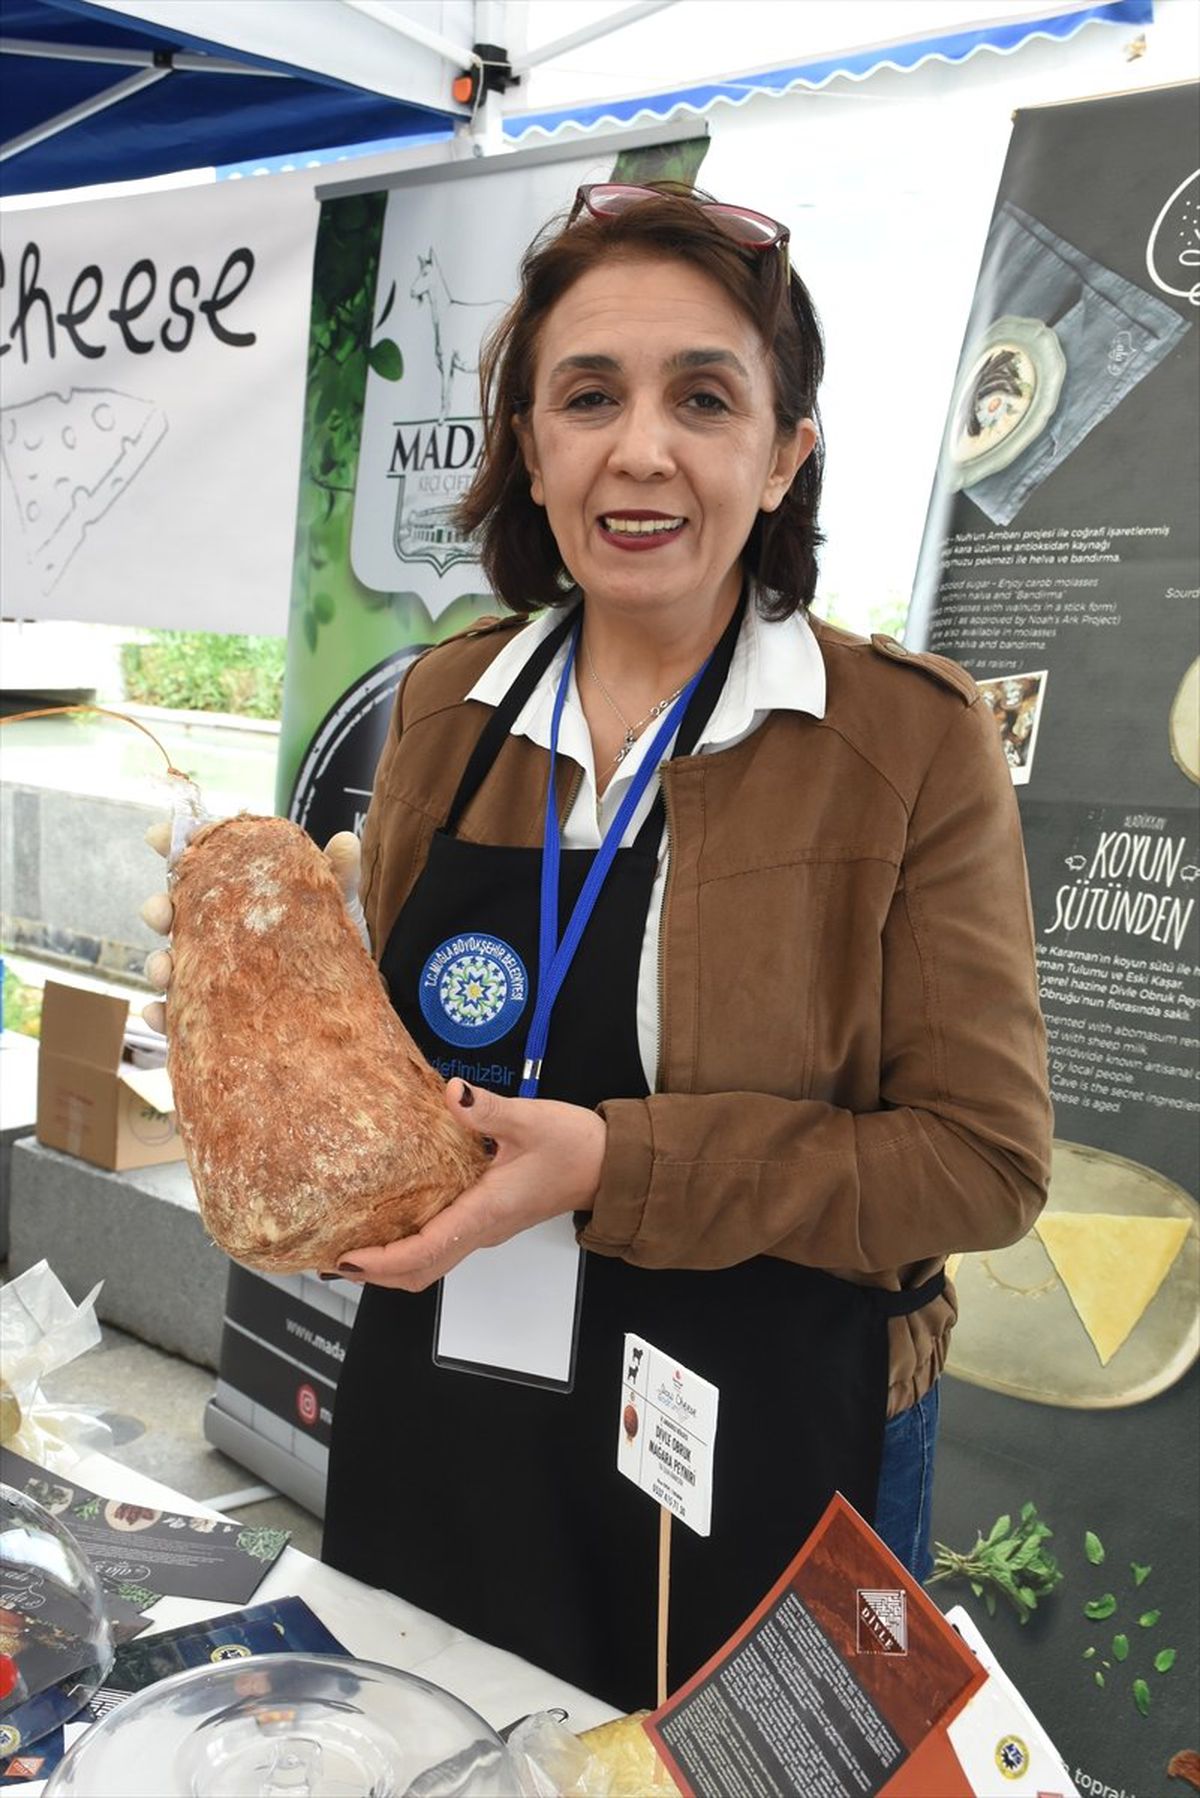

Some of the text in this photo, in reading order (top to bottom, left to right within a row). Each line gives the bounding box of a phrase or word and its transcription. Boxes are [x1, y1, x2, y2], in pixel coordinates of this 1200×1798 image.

[0, 241, 256, 364] heese
[1022, 529, 1056, 541] projesi
[1057, 528, 1069, 538] ile
[1071, 527, 1106, 539] coğrafi
[1002, 543, 1013, 552] ve
[1088, 831, 1186, 888] KOYUN
[1044, 878, 1195, 951] SÜTÜNDEN
[1067, 962, 1109, 979] Tulumu
[1110, 971, 1124, 981] ve
[1125, 971, 1150, 985] Eski
[1112, 954, 1147, 970] koyun
[1070, 977, 1108, 994] hazine
[1108, 983, 1138, 998] Divle
[1139, 988, 1175, 1004] Obruk
[1052, 1059, 1068, 1073] by
